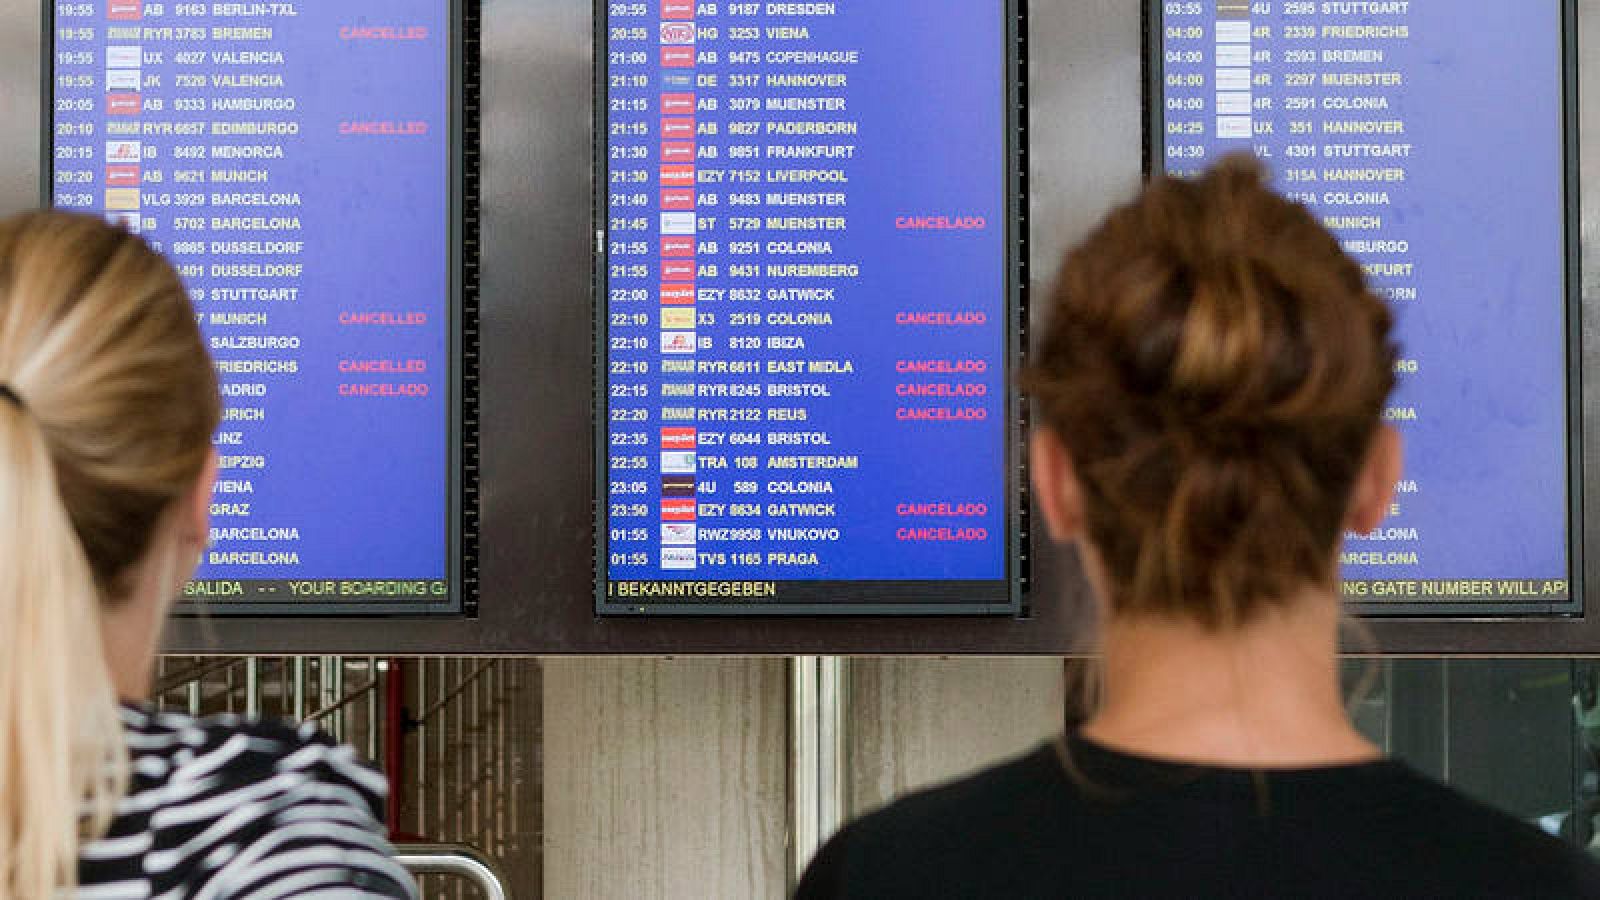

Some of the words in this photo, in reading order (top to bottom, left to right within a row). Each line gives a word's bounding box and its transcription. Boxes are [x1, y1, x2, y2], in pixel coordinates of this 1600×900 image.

[213, 3, 297, 17] BERLIN-TXL
[695, 3, 718, 17] AB
[765, 3, 835, 17] DRESDEN
[1321, 1, 1409, 15] STUTTGART
[211, 26, 273, 41] BREMEN
[339, 26, 427, 39] CANCELLED
[765, 27, 809, 41] VIENA
[1321, 25, 1409, 39] FRIEDRICHS
[211, 51, 285, 65] VALENCIA
[695, 51, 717, 65] AB
[765, 51, 859, 65] COPENHAGUE
[1321, 49, 1383, 63] BREMEN
[211, 74, 283, 87] VALENCIA
[697, 73, 717, 87] DE
[765, 73, 847, 87] HANNOVER
[1321, 73, 1401, 87] MUENSTER
[211, 97, 295, 111] HAMBURGO
[697, 97, 719, 111] AB
[765, 97, 847, 111] MUENSTER
[1321, 97, 1389, 111] COLONIA
[211, 121, 299, 135] EDIMBURGO
[339, 121, 427, 135] CANCELLED
[697, 121, 719, 135] AB
[767, 121, 857, 135] PADERBORN
[1323, 121, 1403, 135] HANNOVER
[211, 145, 283, 159] MENORCA
[697, 145, 719, 159] AB
[767, 145, 855, 159] FRANKFURT
[1323, 143, 1413, 157] STUTTGART
[211, 169, 268, 183] MUNICH
[697, 169, 725, 183] EZY
[729, 169, 761, 183] 7152
[767, 169, 849, 183] LIVERPOOL
[1323, 168, 1405, 181] HANNOVER
[211, 193, 301, 207] BARCELONA
[697, 193, 719, 207] AB
[765, 193, 847, 207] MUENSTER
[1323, 191, 1391, 205] COLONIA
[211, 217, 301, 231] BARCELONA
[765, 216, 847, 231] MUENSTER
[895, 216, 986, 229] CANCELADO
[1323, 215, 1381, 229] MUNICH
[211, 241, 303, 255] DUSSELDORF
[697, 241, 719, 255] AB
[767, 241, 833, 255] COLONIA
[211, 263, 303, 277] DUSSELDORF
[695, 263, 719, 277] AB
[767, 263, 859, 277] NUREMBERG
[211, 287, 299, 301] STUTTGART
[697, 287, 727, 301] EZY
[767, 287, 835, 301] GATWICK
[209, 312, 267, 325] MUNICH
[338, 312, 427, 325] CANCELLED
[767, 312, 833, 325] COLONIA
[895, 312, 987, 325] CANCELADO
[209, 335, 301, 349] SALZBURGO
[697, 335, 713, 349] IB
[767, 335, 805, 349] IBIZA
[337, 359, 427, 373] CANCELLED
[697, 359, 729, 373] RYR
[767, 359, 805, 373] EAST
[808, 359, 854, 373] MIDLA
[895, 359, 987, 373] CANCELADO
[217, 383, 268, 397] ADRID
[338, 383, 429, 397] CANCELADO
[697, 383, 729, 397] RYR
[767, 383, 831, 397] BRISTOL
[895, 383, 987, 397] CANCELADO
[697, 407, 729, 421] RYR
[729, 407, 762, 421] 2122
[767, 407, 807, 421] REUS
[895, 407, 987, 421] CANCELADO
[697, 431, 725, 445] EZY
[767, 431, 831, 445] BRISTOL
[214, 455, 266, 469] EIPZIG
[697, 455, 729, 469] TRA
[767, 455, 859, 469] AMSTERDAM
[697, 481, 717, 495] 4U
[767, 481, 833, 495] COLONIA
[208, 502, 251, 517] GRAZ
[697, 503, 727, 517] EZY
[767, 503, 835, 517] GATWICK
[895, 503, 988, 517] CANCELADO
[209, 527, 300, 541] BARCELONA
[697, 527, 729, 541] RWZ
[767, 527, 840, 541] VNUKOVO
[895, 527, 988, 541] CANCELADO
[209, 551, 299, 565] BARCELONA
[697, 551, 727, 565] TVS
[767, 551, 819, 565] PRAGA
[1338, 551, 1419, 565] ARCELONA
[183, 581, 244, 595] SALIDA
[287, 580, 336, 595] YOUR
[339, 580, 426, 595] BOARDING
[617, 581, 776, 597] BEKANNTGEGEBEN
[1372, 581, 1418, 595] GATE
[1421, 581, 1494, 595] NUMBER
[1497, 581, 1538, 595] WILL
